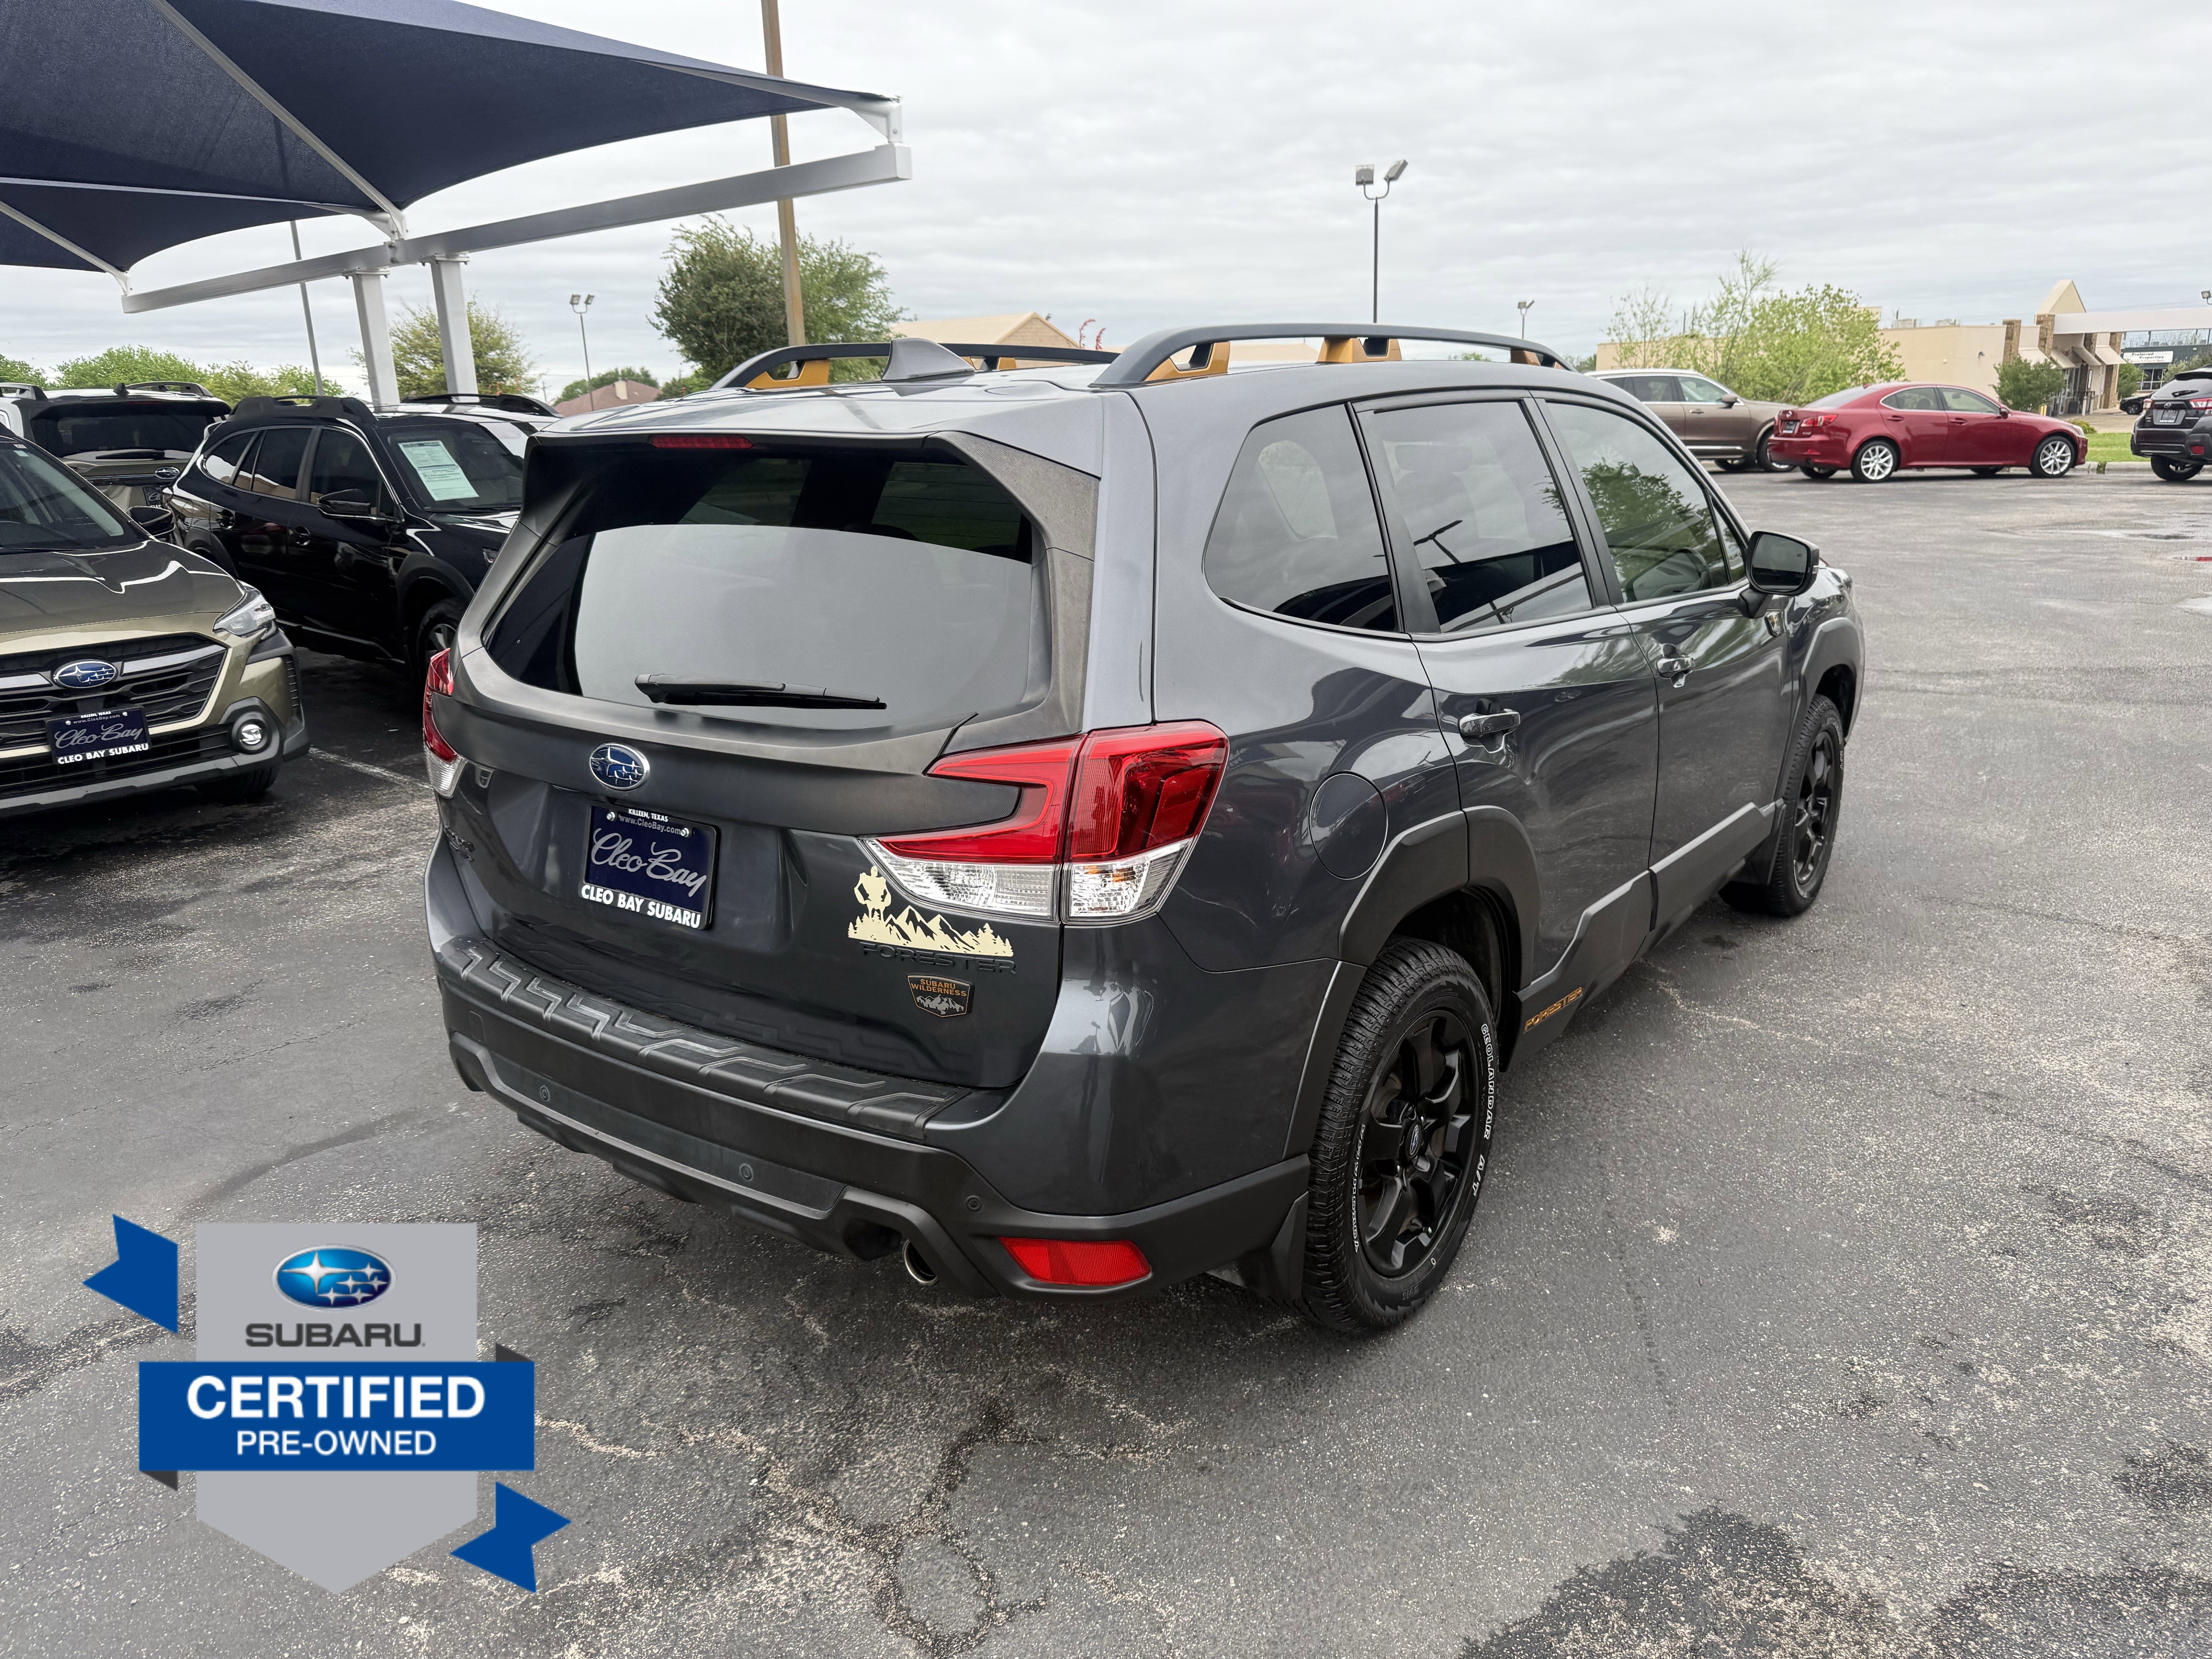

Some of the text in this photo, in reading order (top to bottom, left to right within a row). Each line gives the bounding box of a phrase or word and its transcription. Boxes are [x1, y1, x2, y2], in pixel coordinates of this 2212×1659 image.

[54, 723, 143, 749] Cleo Bay
[58, 743, 149, 764] CLEO BAY SUBARU
[618, 815, 683, 835] www.CleoBay.com
[629, 808, 668, 822] KILLEEN, TEXAS
[591, 828, 707, 897] Cleo Bay
[581, 884, 701, 928] CLEO BAY SUBARU
[860, 942, 1017, 974] FORESTER
[911, 983, 967, 996] WILDERNESS
[920, 979, 956, 989] SUBARU
[1524, 987, 1583, 1033] FORESTER
[1481, 1024, 1494, 1140] GEOLANDAR
